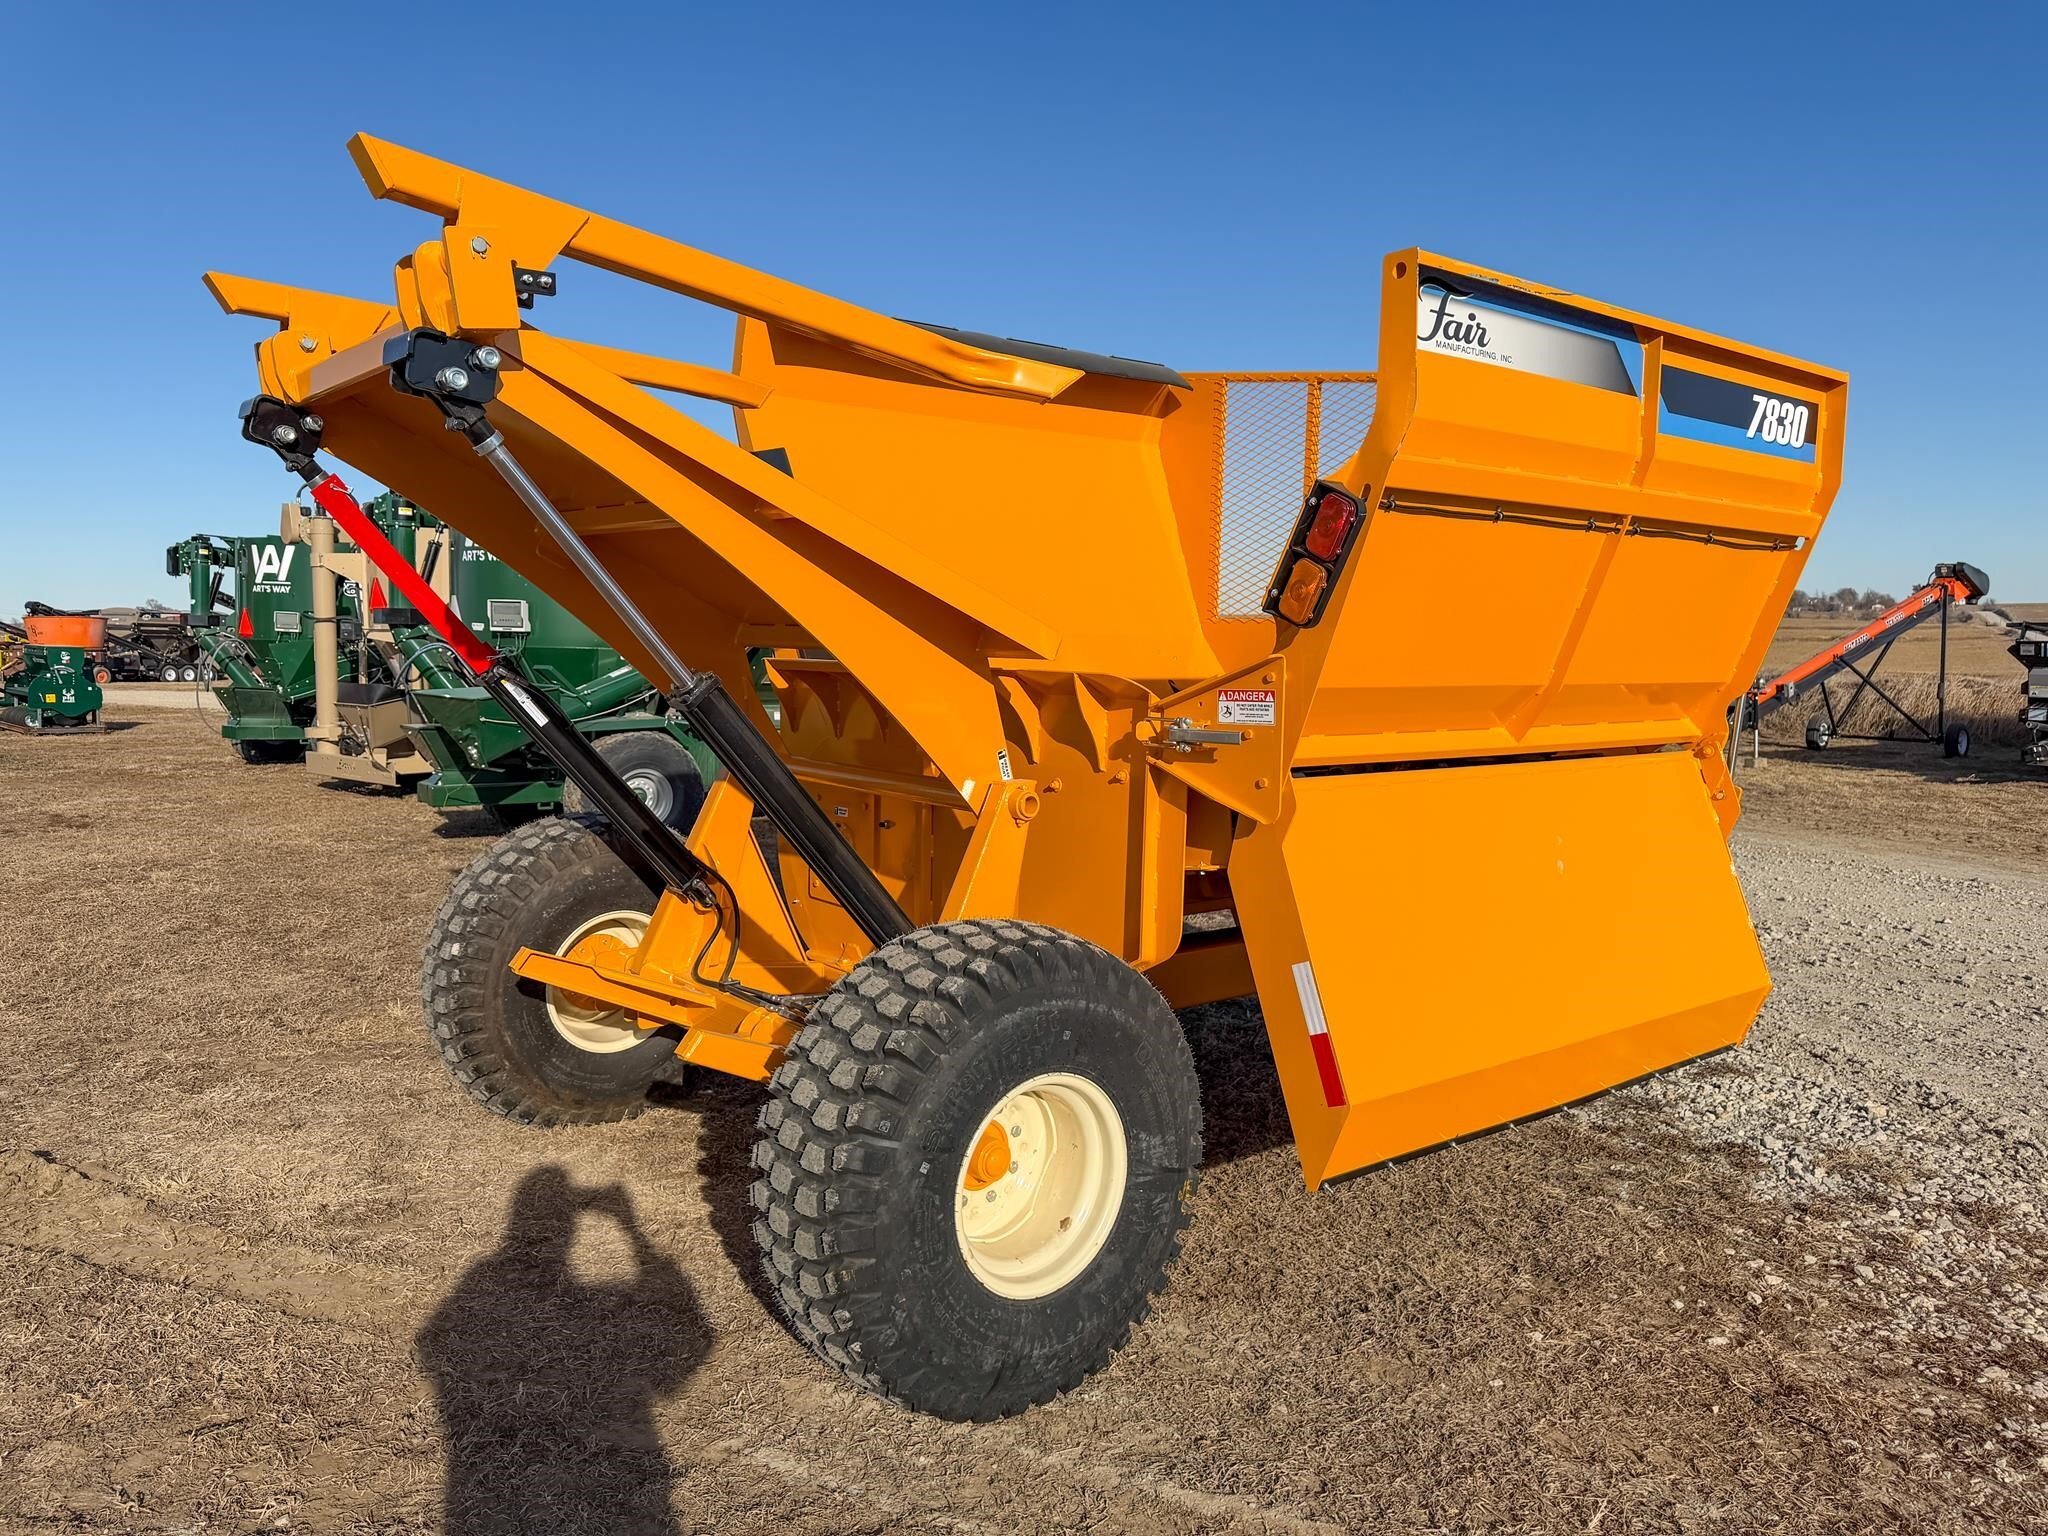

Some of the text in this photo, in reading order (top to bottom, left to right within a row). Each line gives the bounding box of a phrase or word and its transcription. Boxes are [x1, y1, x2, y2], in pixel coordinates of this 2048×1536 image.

[1417, 276, 1491, 348] Fair
[1435, 340, 1515, 364] MANUFACTURING, INC.
[1746, 394, 1809, 449] 7830
[462, 550, 485, 561] ART'S
[252, 584, 292, 593] ART'S WAY
[1227, 691, 1266, 701] DANGER
